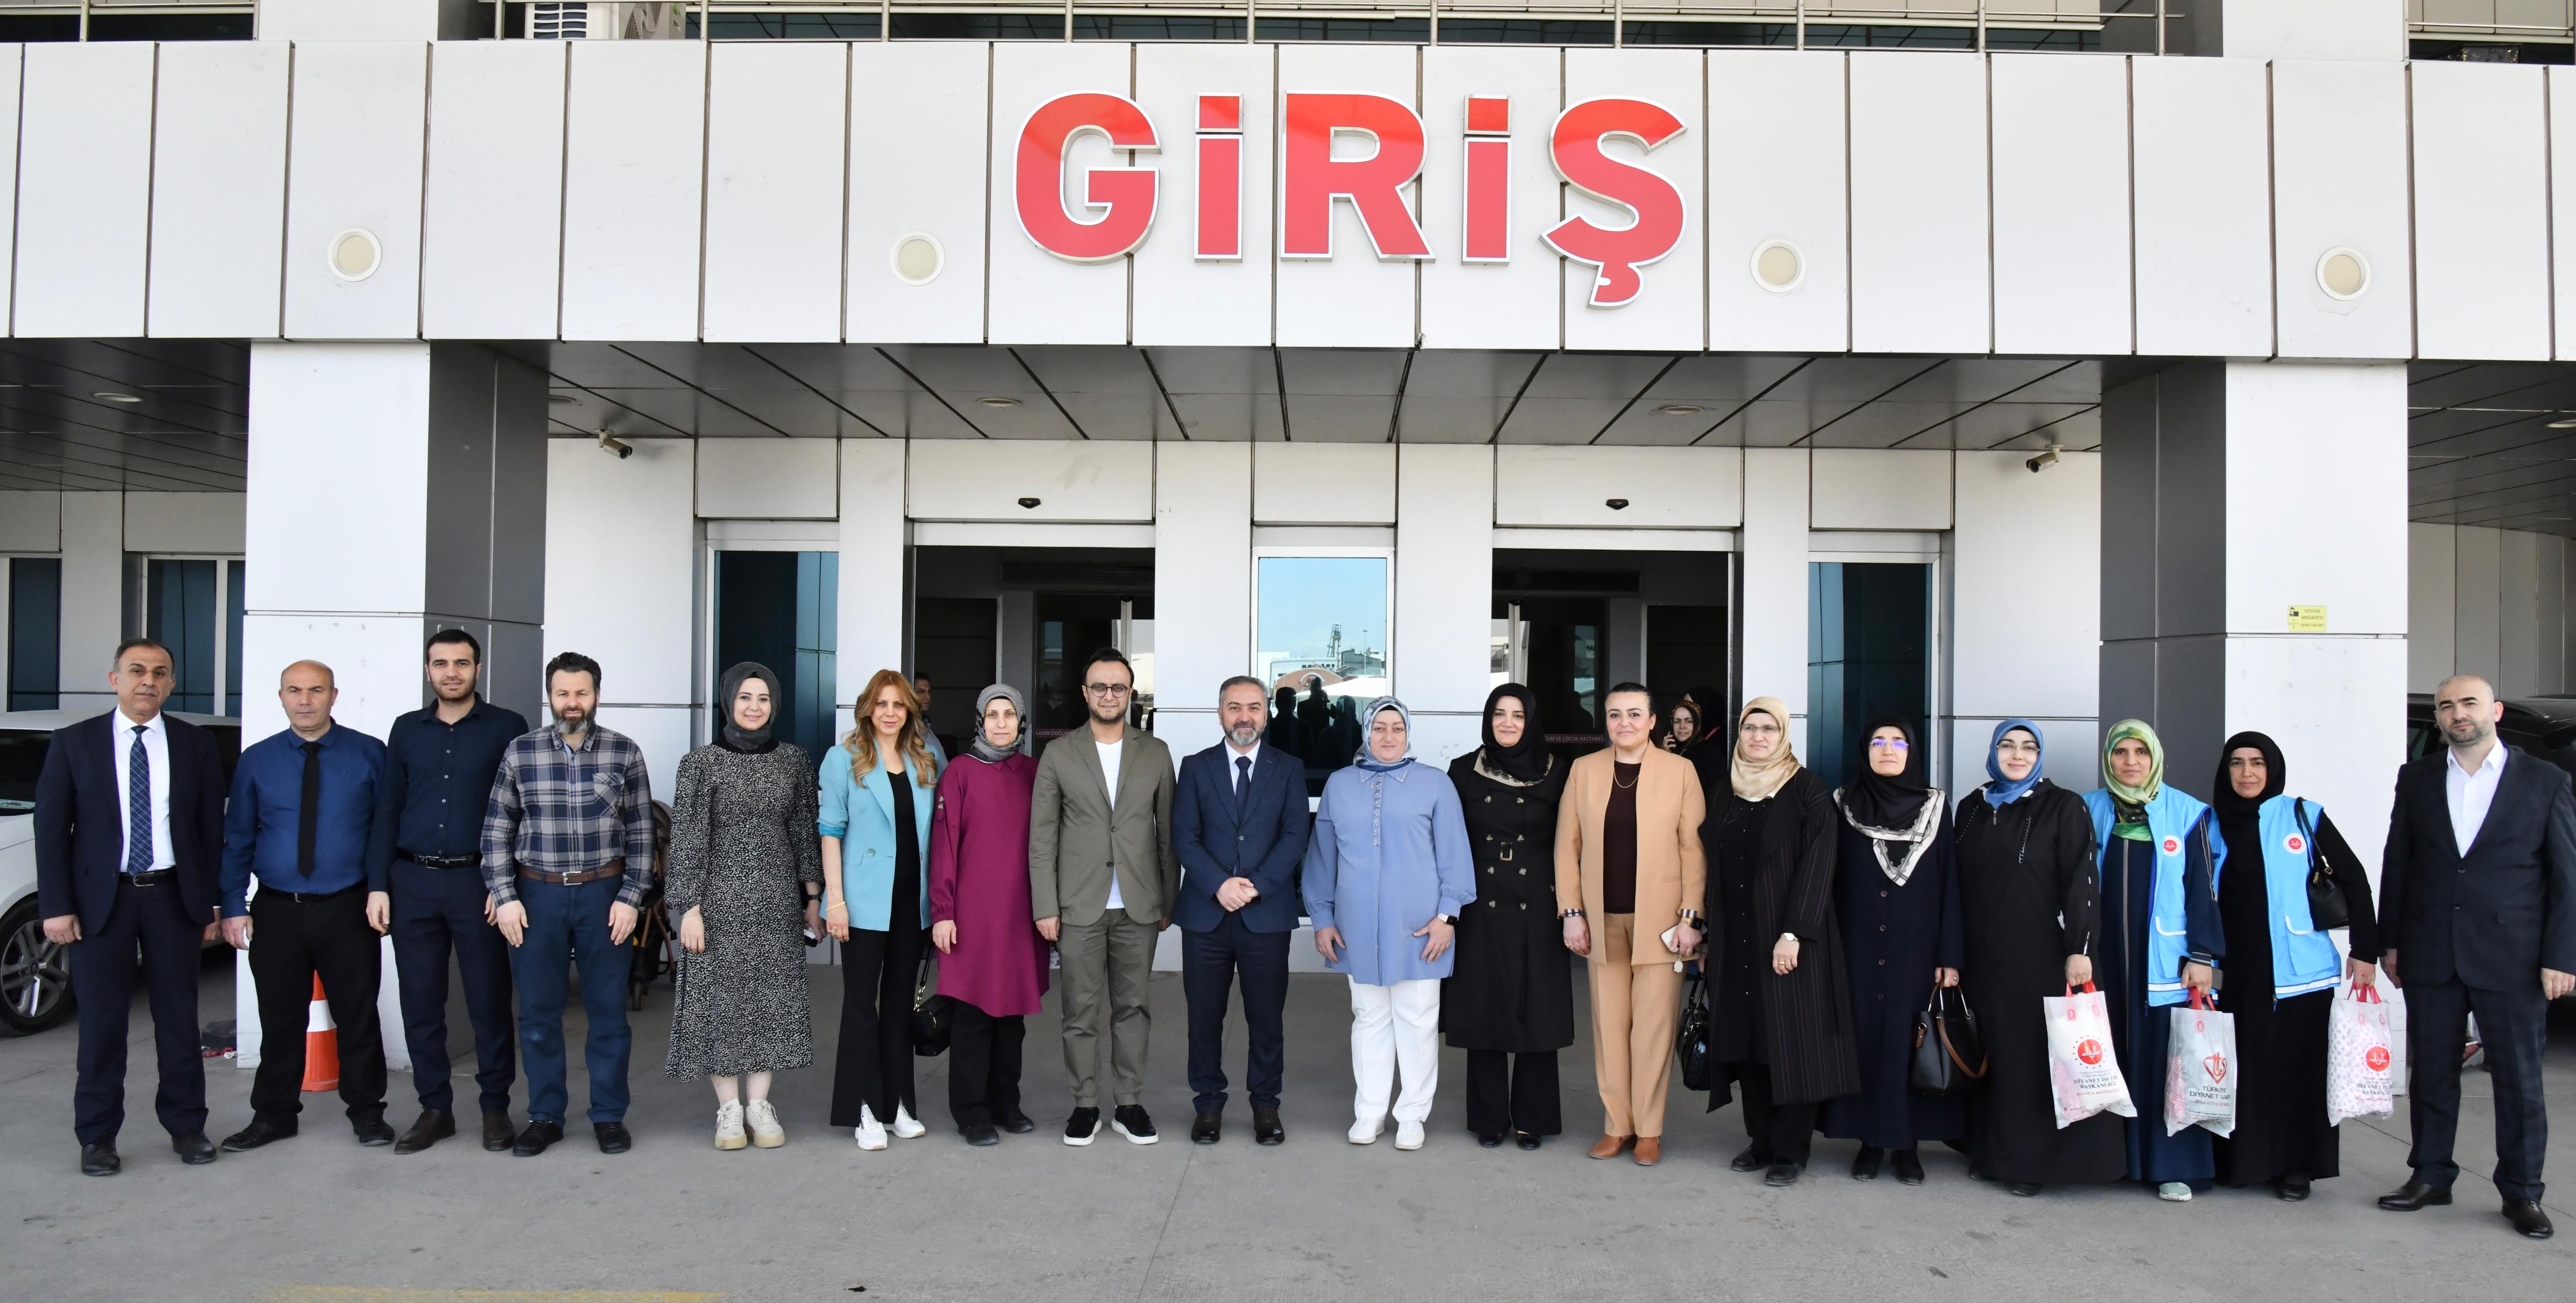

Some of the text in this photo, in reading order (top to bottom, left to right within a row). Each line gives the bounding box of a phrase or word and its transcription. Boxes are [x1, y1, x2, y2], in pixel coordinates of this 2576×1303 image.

[1013, 90, 1688, 310] GİRİŞ
[2080, 1081, 2116, 1089] BAŞKANLIĞI
[2190, 1091, 2219, 1099] DİYANET
